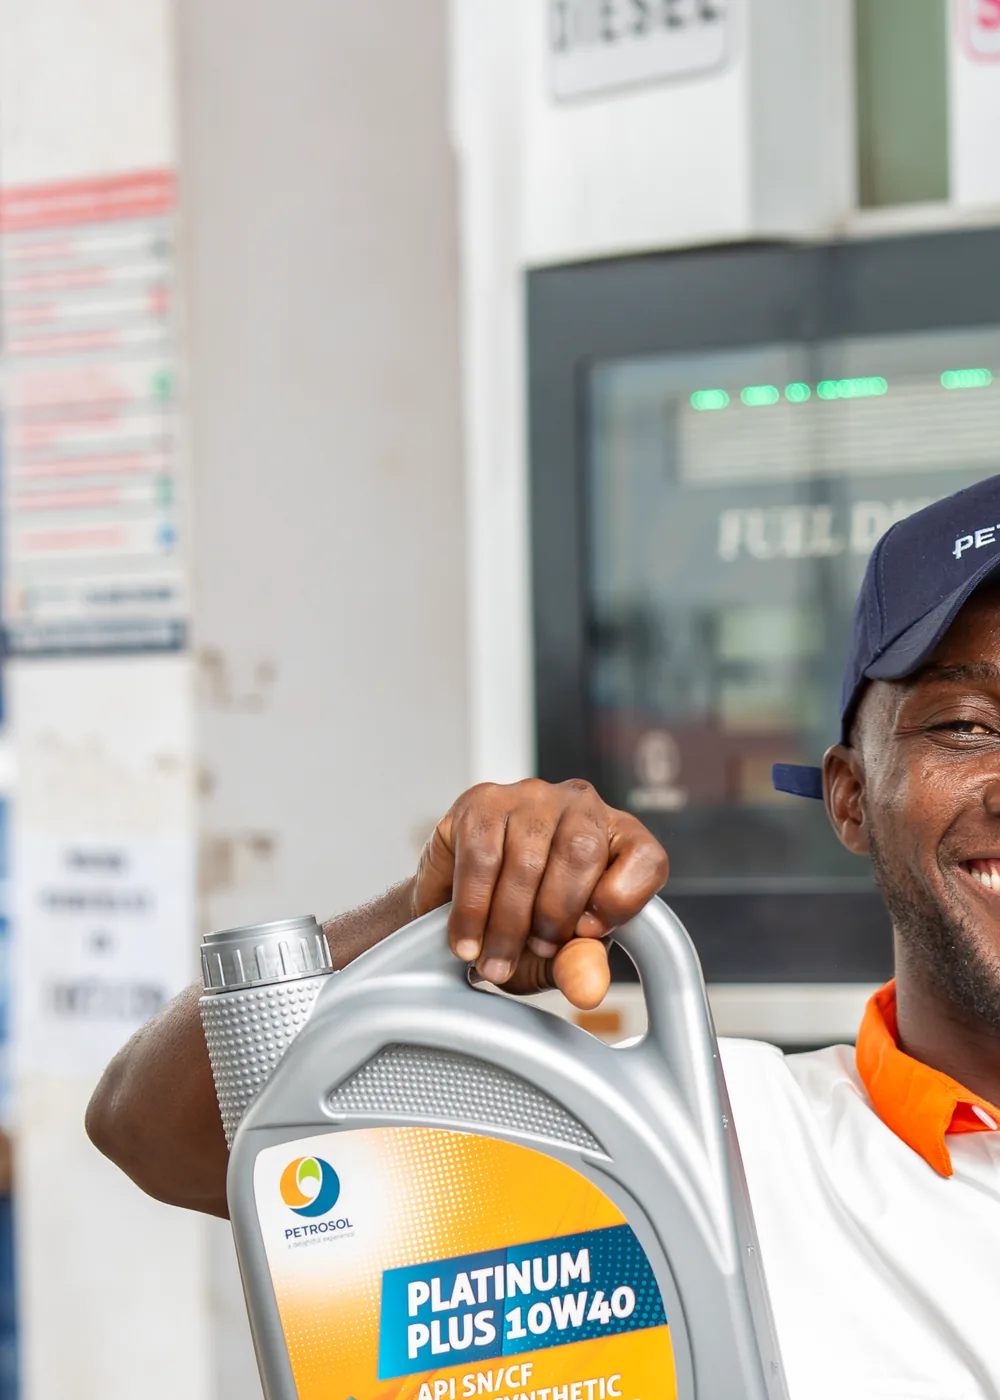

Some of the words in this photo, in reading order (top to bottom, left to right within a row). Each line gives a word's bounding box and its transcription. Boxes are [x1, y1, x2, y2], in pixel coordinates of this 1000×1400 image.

[285, 1218, 354, 1239] PETROSOL
[408, 1248, 591, 1317] PLATINUM
[408, 1309, 496, 1359] PLUS
[505, 1286, 636, 1340] 10W40
[462, 1362, 533, 1397] SN/CF
